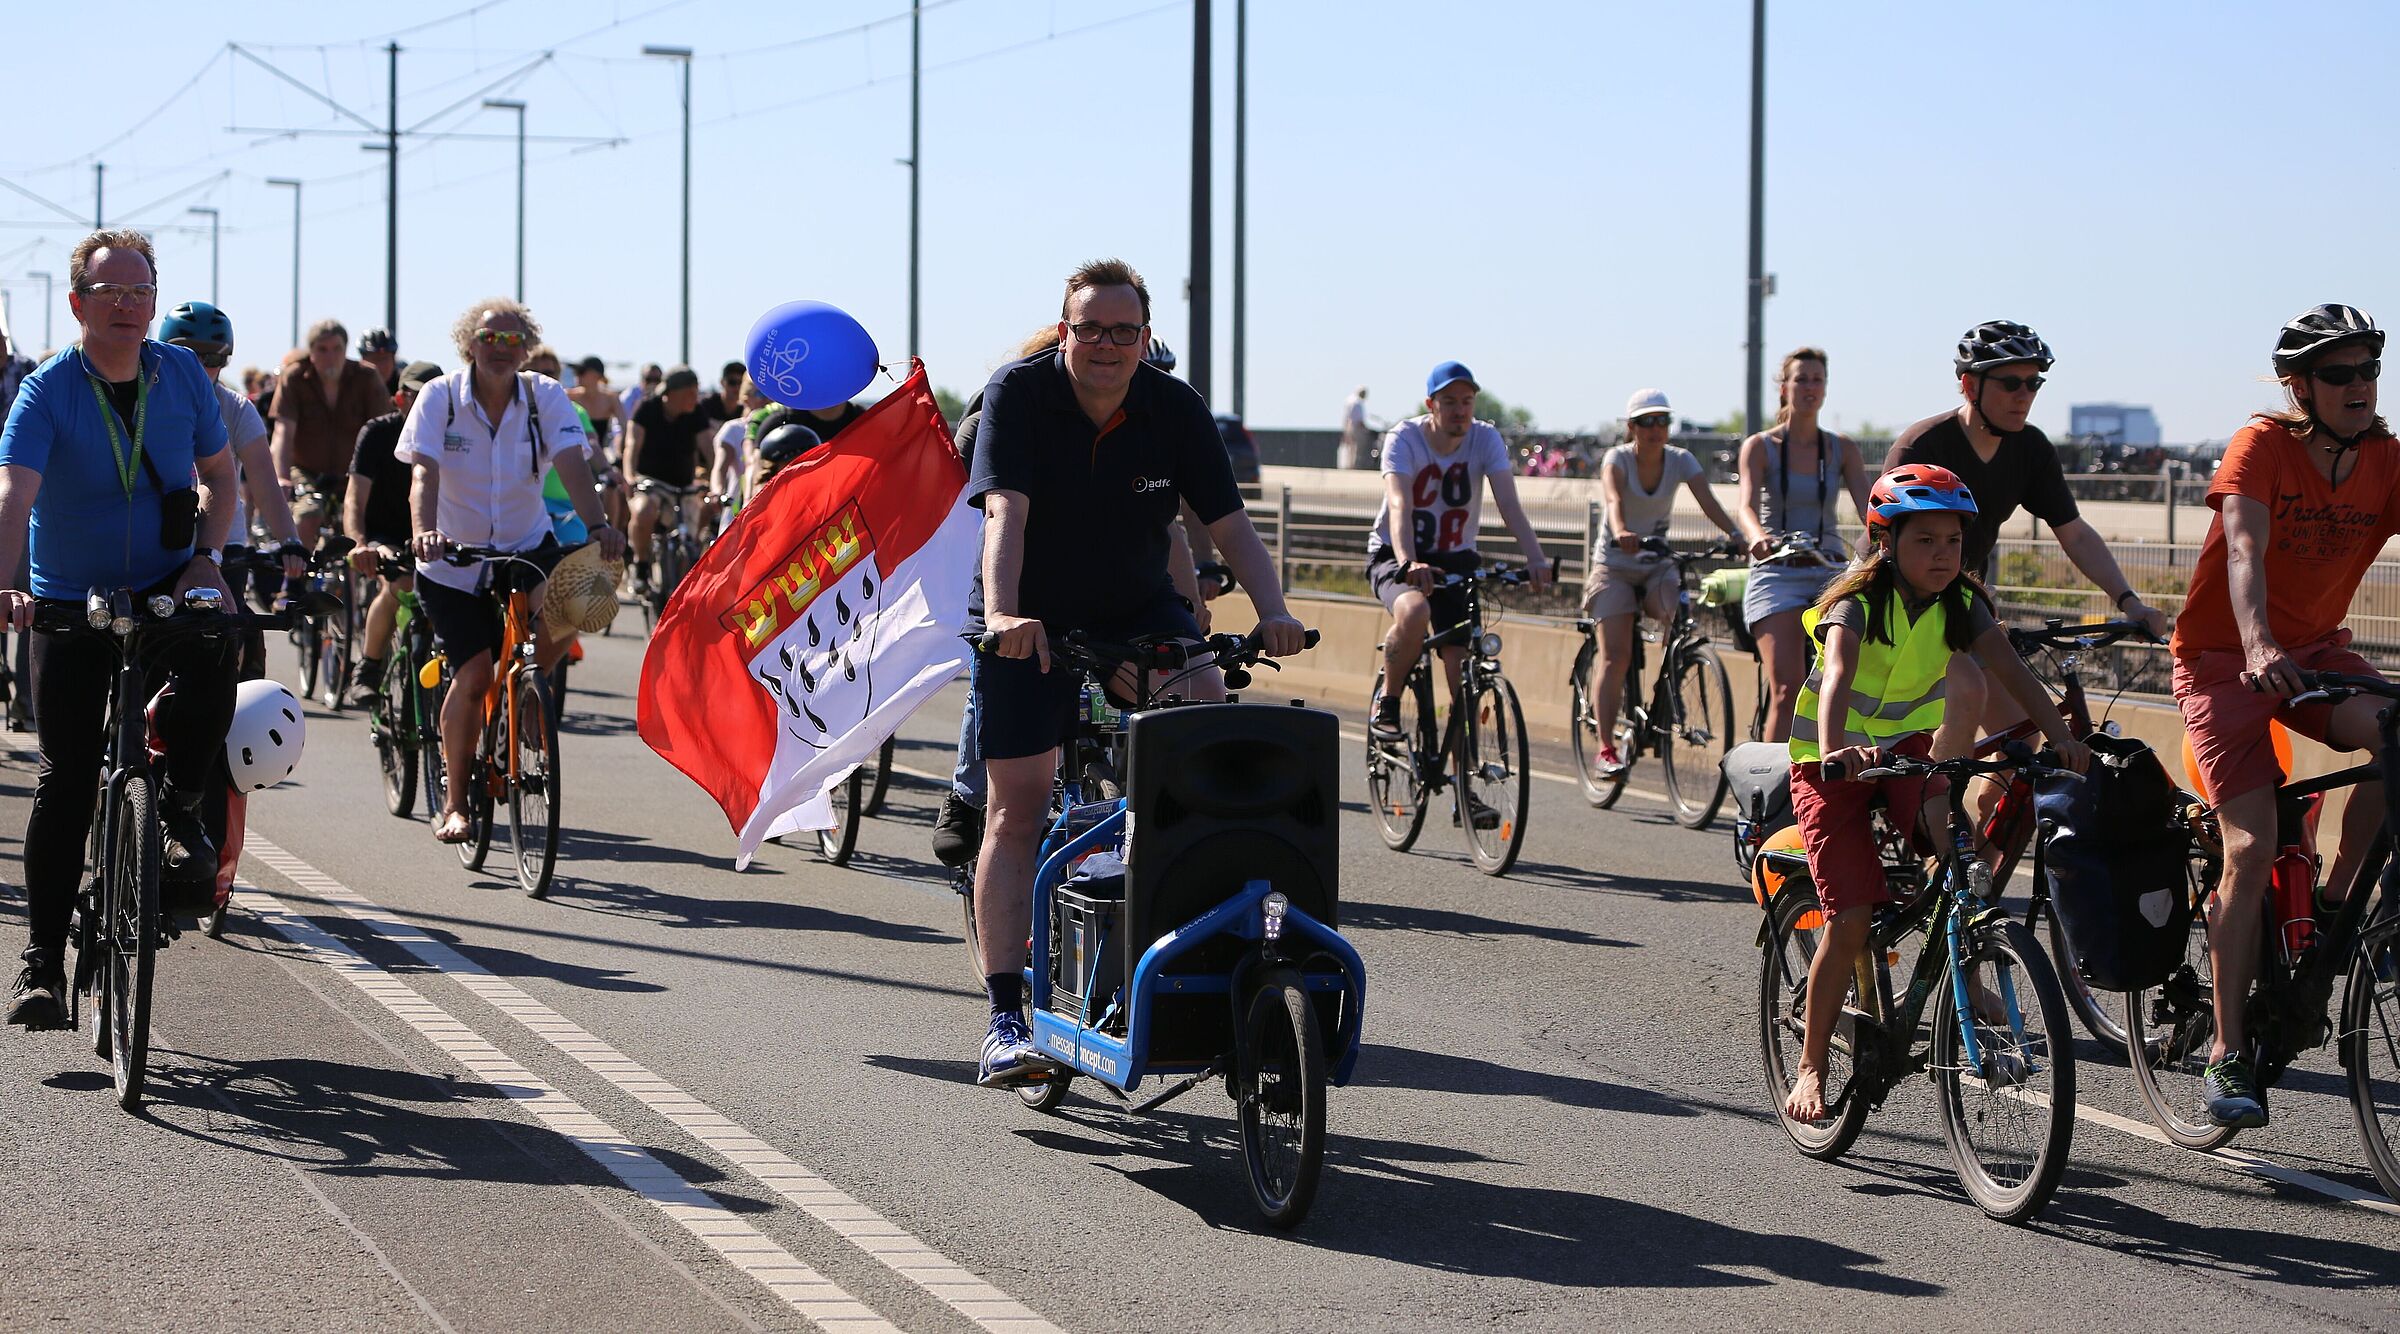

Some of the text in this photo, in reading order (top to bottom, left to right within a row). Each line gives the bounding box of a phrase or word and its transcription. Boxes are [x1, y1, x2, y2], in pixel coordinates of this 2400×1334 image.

[757, 328, 778, 386] Rauf aufs
[1148, 478, 1171, 488] adfc
[1412, 461, 1472, 508] CO
[2295, 543, 2311, 556] OF
[1051, 1033, 1116, 1076] messageoncept.com
